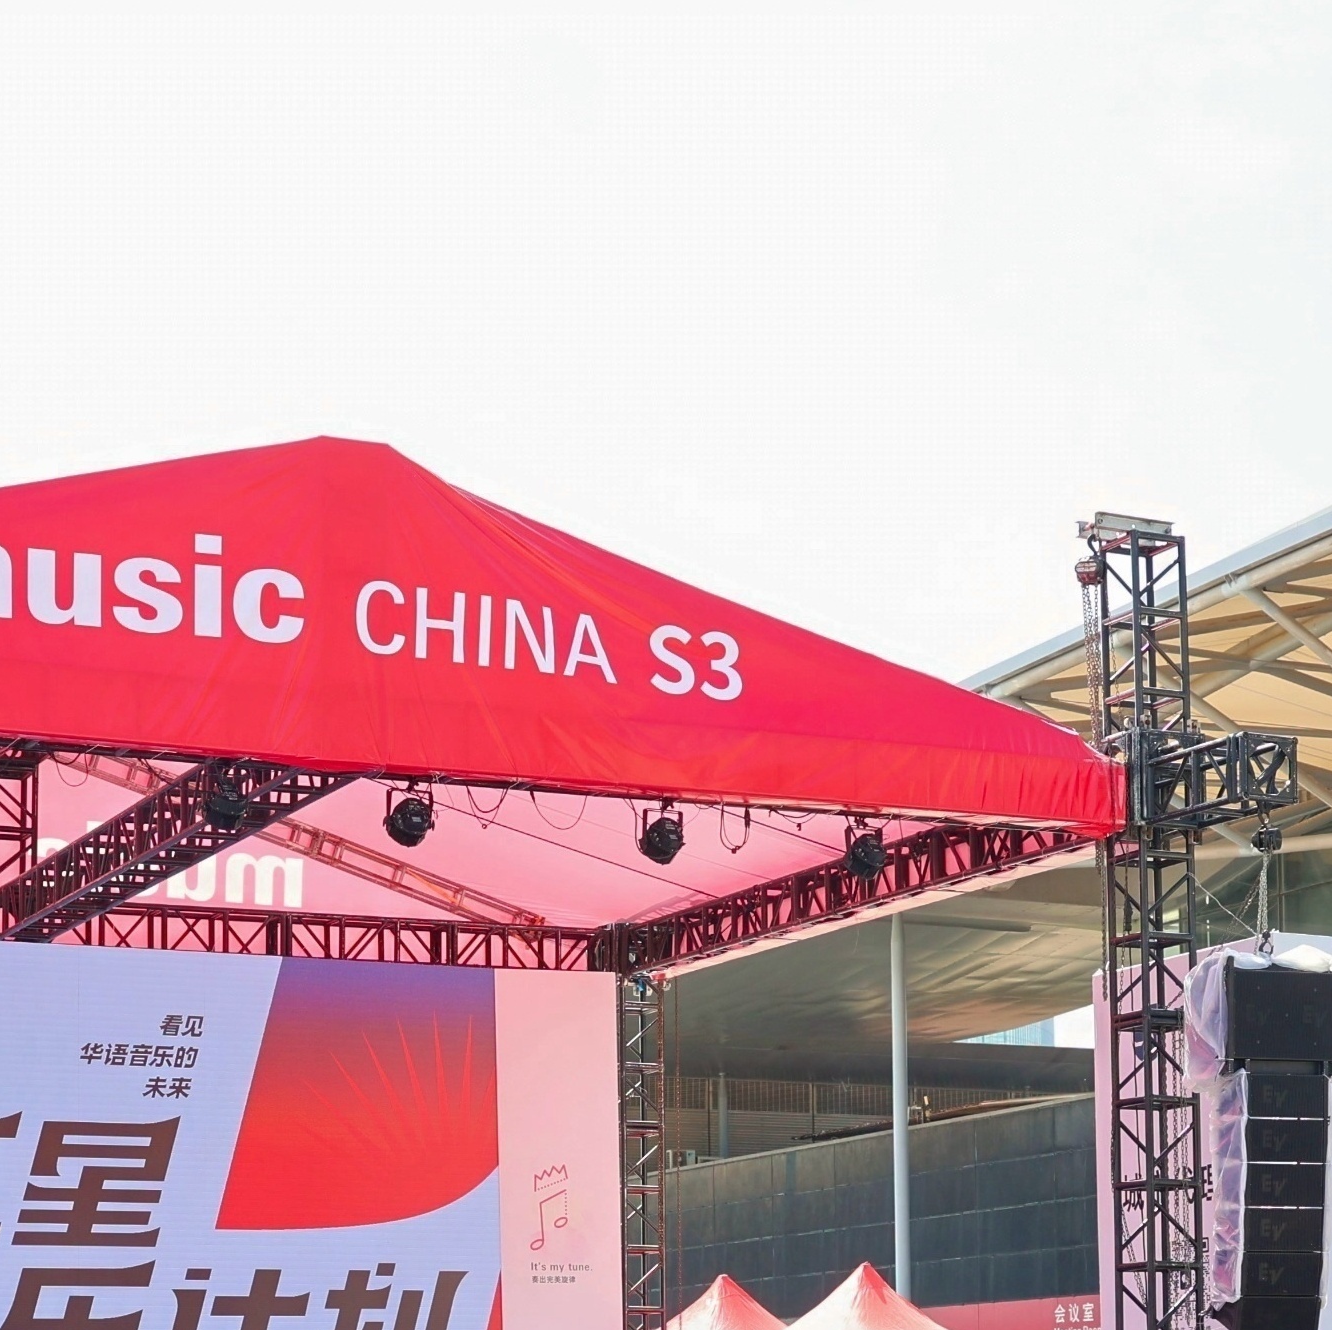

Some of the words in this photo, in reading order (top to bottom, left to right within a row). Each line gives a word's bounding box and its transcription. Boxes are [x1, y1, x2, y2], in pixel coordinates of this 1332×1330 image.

[355, 578, 619, 687] CHINA
[648, 626, 745, 703] S3
[159, 1014, 204, 1038] 看见
[79, 1042, 198, 1069] 华语音乐的
[143, 1076, 192, 1099] 未来
[530, 1262, 547, 1272] It's
[550, 1264, 564, 1273] my
[1054, 1302, 1095, 1324] 会议室
